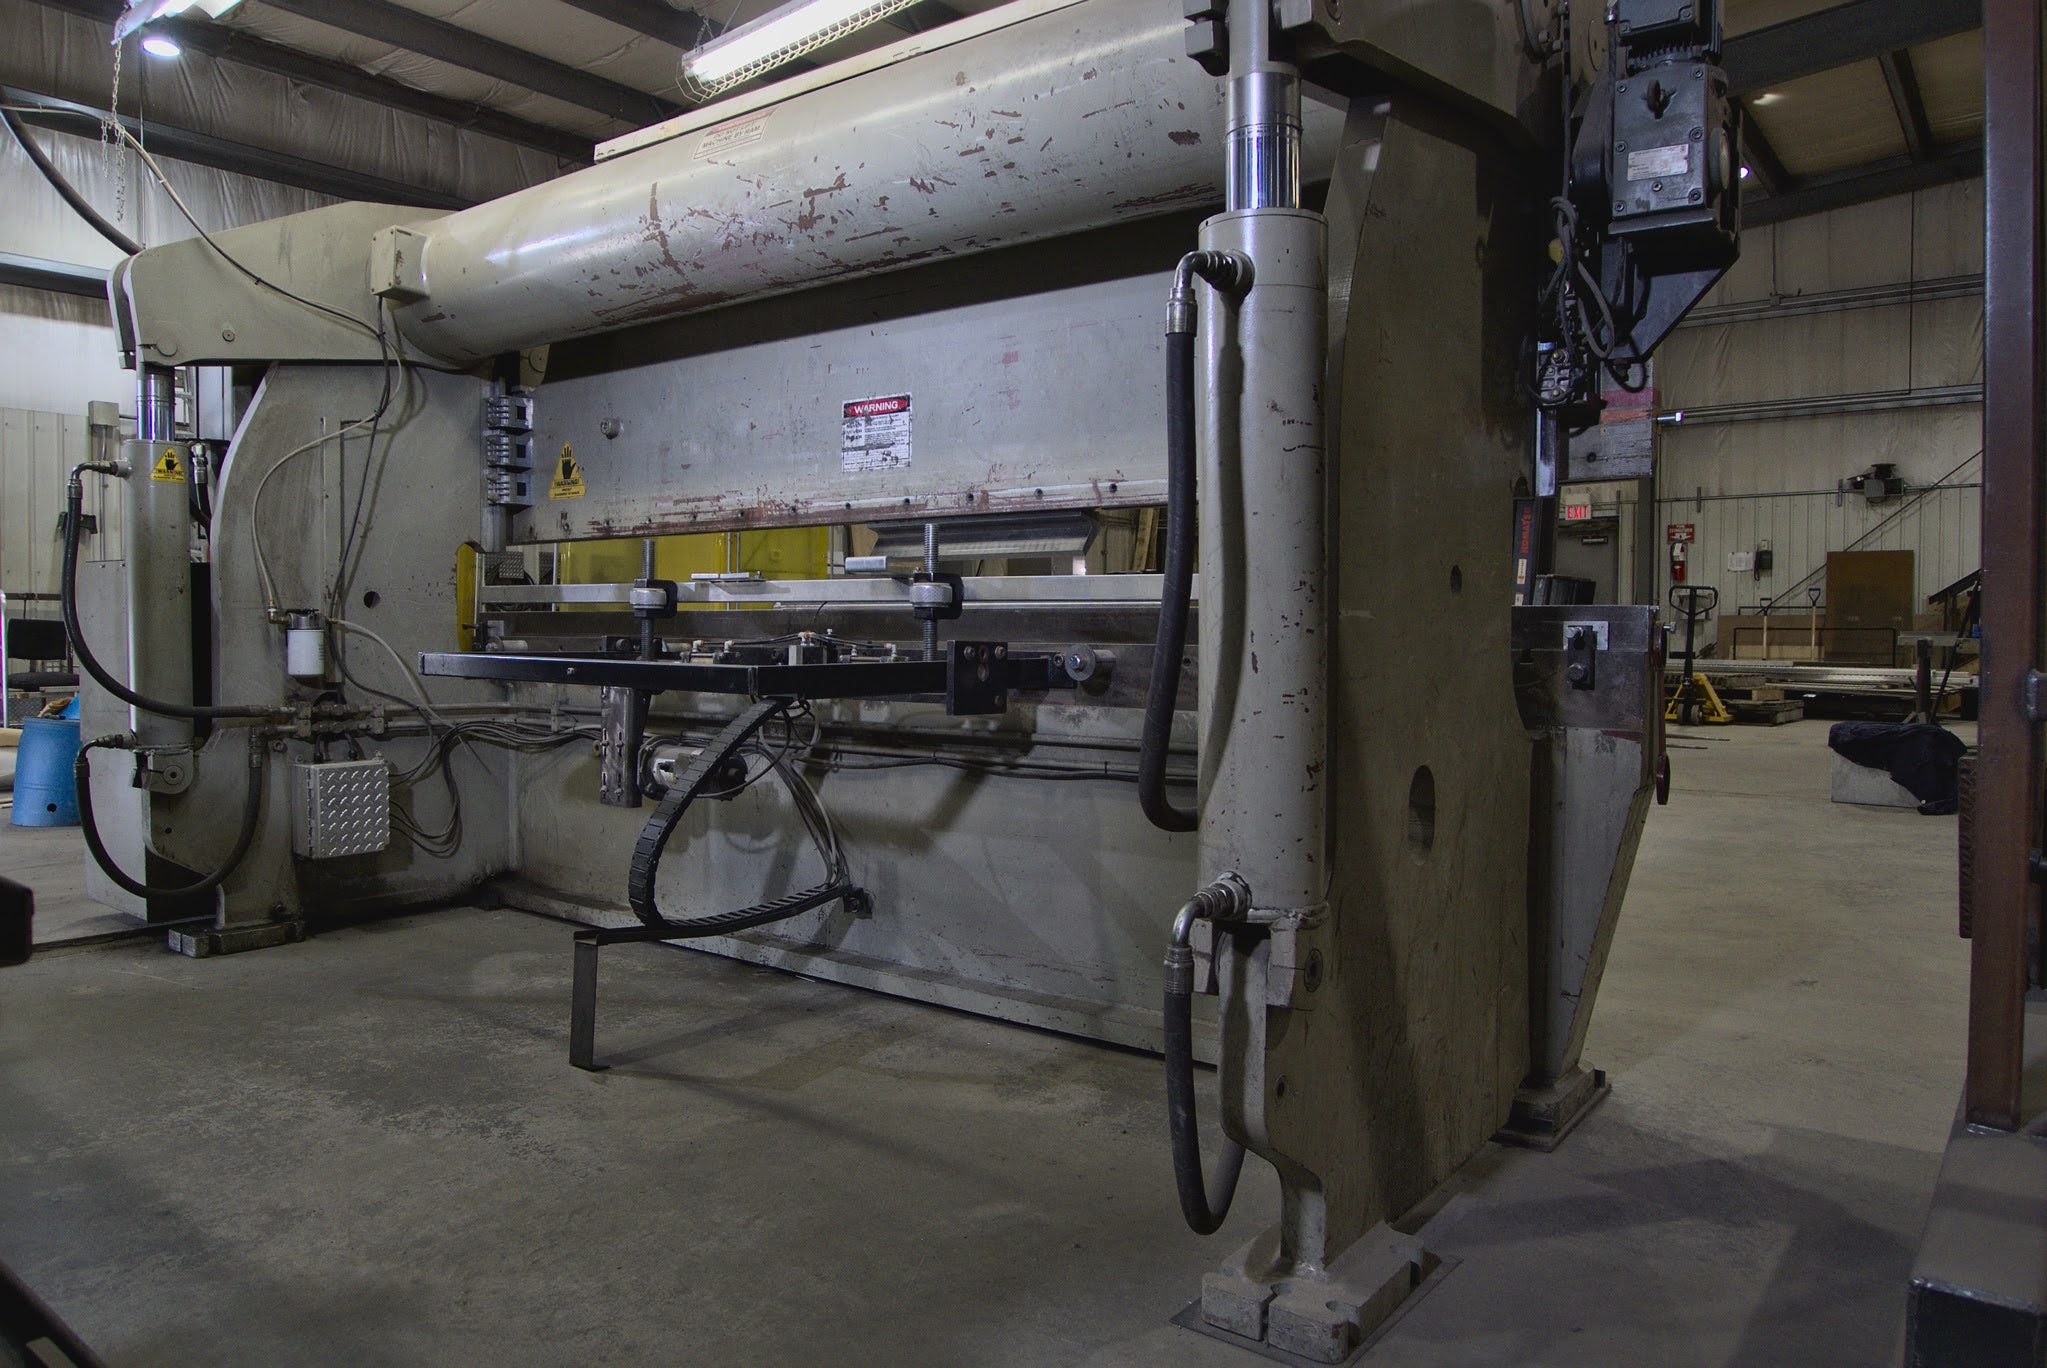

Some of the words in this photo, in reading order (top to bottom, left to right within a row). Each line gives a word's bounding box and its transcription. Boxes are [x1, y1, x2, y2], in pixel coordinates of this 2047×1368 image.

[853, 401, 899, 414] WARNING
[1567, 505, 1588, 519] EXIT
[1520, 507, 1532, 554] KOMATSU
